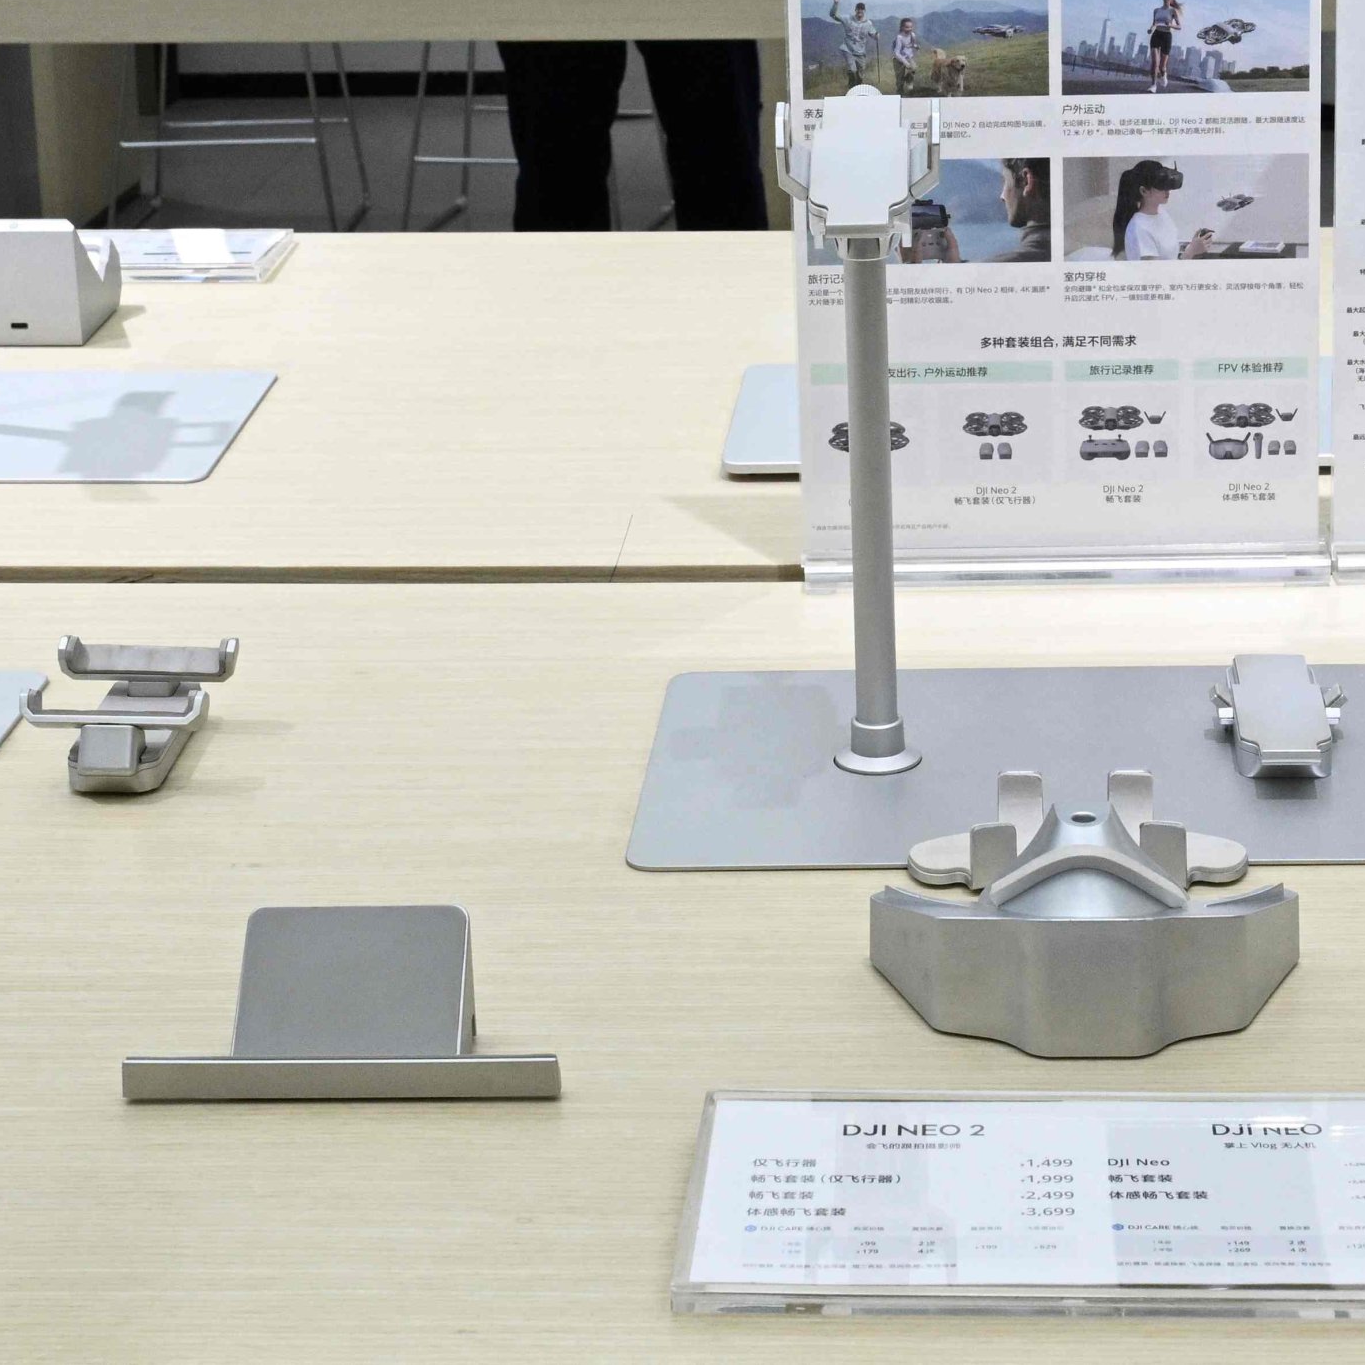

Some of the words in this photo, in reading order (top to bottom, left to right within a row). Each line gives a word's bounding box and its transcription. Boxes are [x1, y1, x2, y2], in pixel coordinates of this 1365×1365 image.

[1062, 104, 1105, 115] 户外运动
[955, 121, 970, 129] Neo
[1181, 117, 1197, 125] Neo
[1198, 117, 1203, 125] 2
[807, 274, 844, 285] 旅行记
[1064, 272, 1106, 282] 室内穿梭
[977, 286, 992, 294] Neo
[980, 335, 1137, 348] 多种套装组合，满足不同需求
[1089, 364, 1154, 376] 旅行记录推荐
[1218, 363, 1237, 373] FPV
[1241, 362, 1284, 373] 体验推荐
[976, 486, 988, 495] DJI
[991, 486, 1009, 494] Neo
[1011, 486, 1017, 494] 2
[1103, 485, 1115, 493] DJI
[1117, 485, 1136, 493] Neo
[1138, 484, 1144, 492] 2
[1229, 483, 1241, 492] DJI
[1243, 483, 1262, 491] Neo
[1264, 483, 1270, 491] 2
[954, 496, 1036, 506] 畅飞套装（仅飞行器）
[1105, 494, 1142, 503] 畅飞套装
[1222, 492, 1276, 502] 体感畅飞套装
[842, 1124, 886, 1136] DJI
[897, 1124, 961, 1136] NEO
[970, 1124, 985, 1136] 2
[1251, 1142, 1278, 1150] Vlog
[753, 1158, 817, 1168] 仅飞行器
[1107, 1158, 1129, 1167] DJI
[1136, 1158, 1170, 1166] Neo
[750, 1174, 902, 1184] 畅飞套装（仅飞行器）
[1108, 1174, 1173, 1183] 畅飞套装
[749, 1190, 814, 1200] 畅飞套装
[1109, 1190, 1208, 1200] 体感畅飞套装
[747, 1207, 847, 1216] 体感畅飞套装
